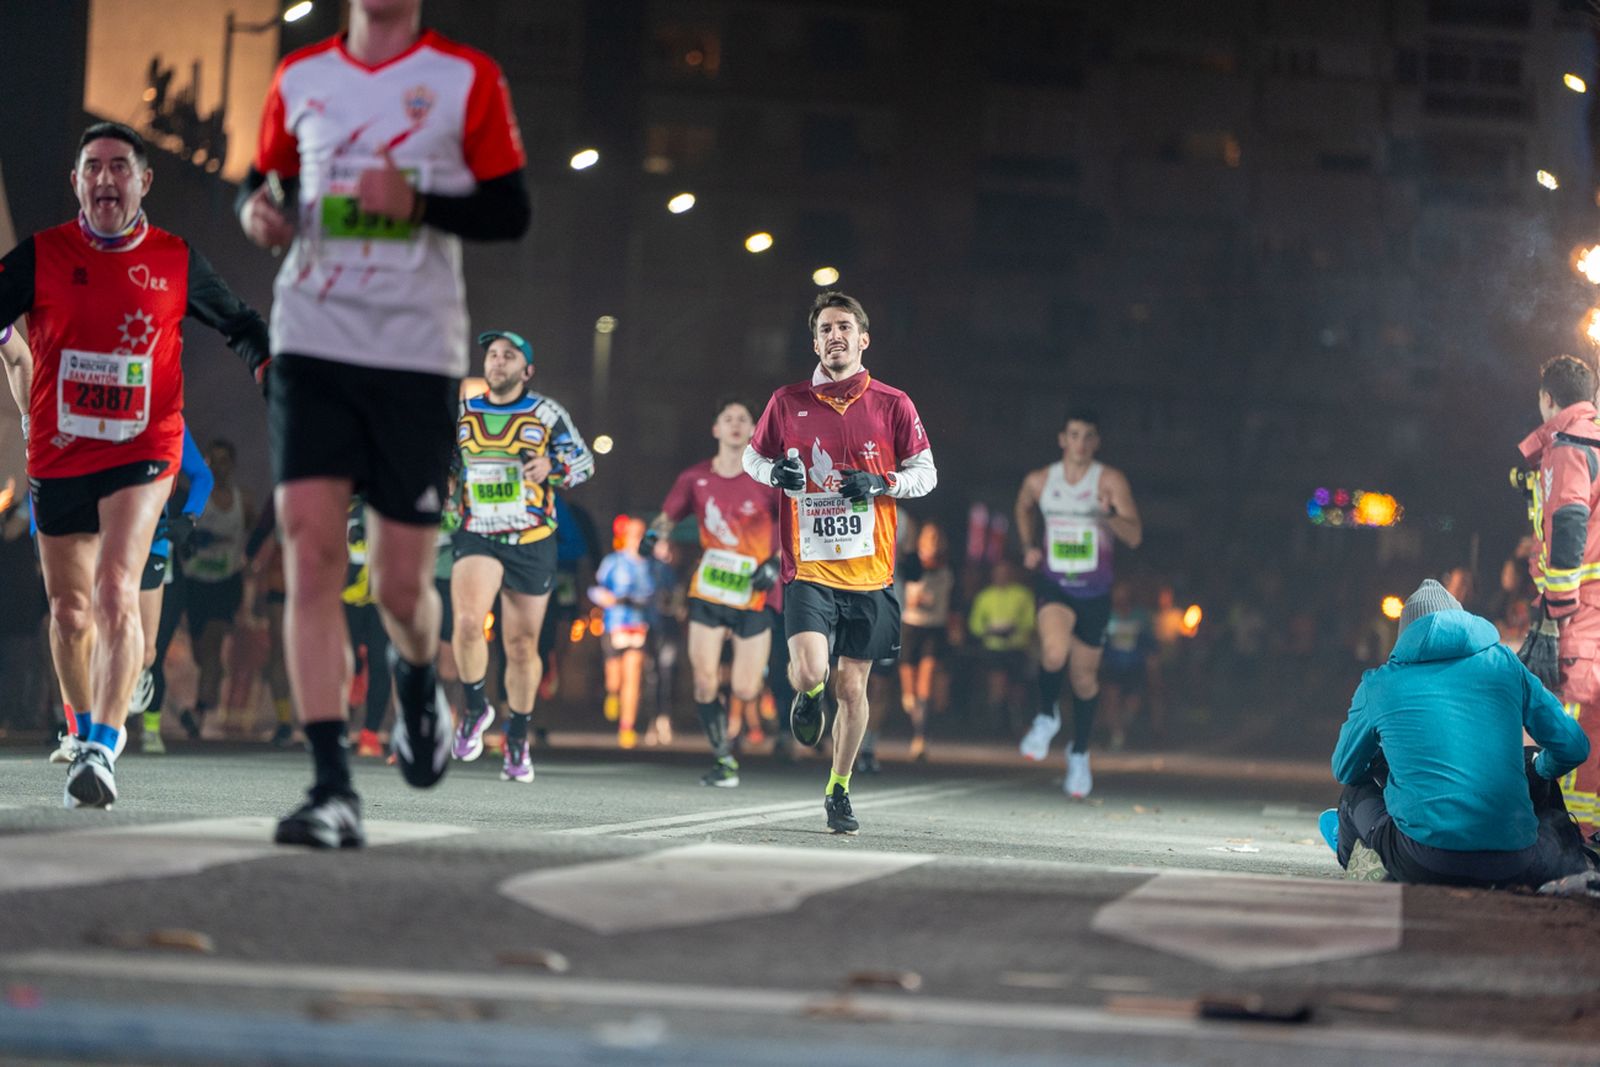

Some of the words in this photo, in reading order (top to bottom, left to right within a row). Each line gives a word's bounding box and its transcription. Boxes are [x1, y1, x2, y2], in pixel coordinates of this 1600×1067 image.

[80, 363, 107, 372] NOCHE
[109, 362, 119, 373] DE
[69, 370, 86, 381] SAN
[76, 382, 133, 411] 2387
[478, 482, 513, 498] 8840
[836, 499, 845, 507] DE
[807, 507, 820, 516] SAN
[813, 515, 862, 537] 4839
